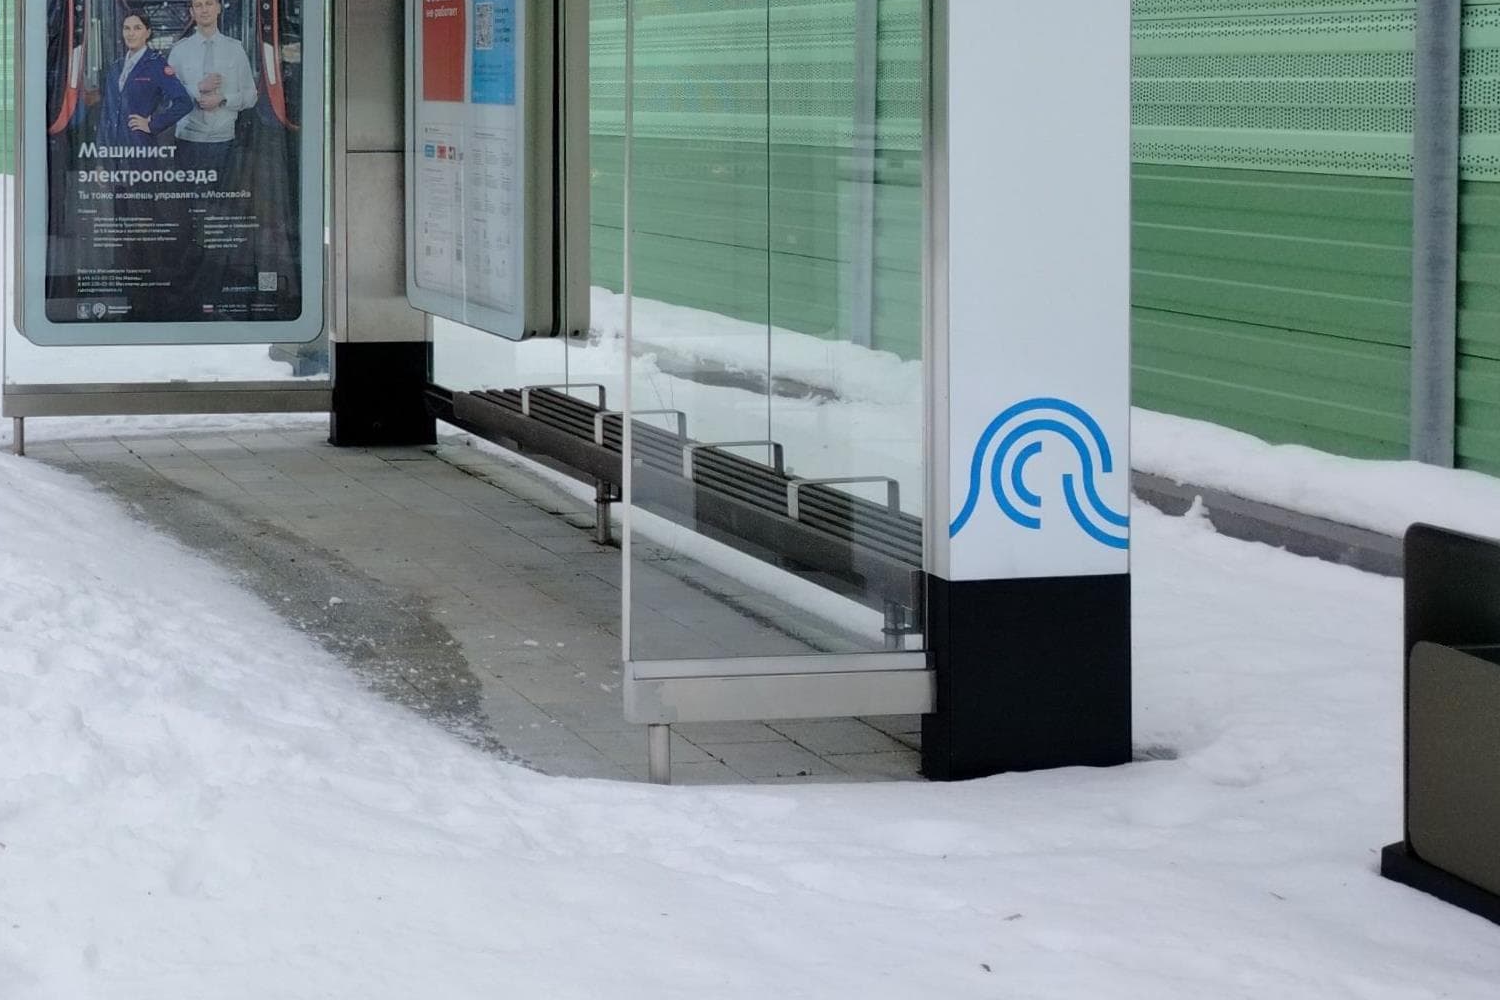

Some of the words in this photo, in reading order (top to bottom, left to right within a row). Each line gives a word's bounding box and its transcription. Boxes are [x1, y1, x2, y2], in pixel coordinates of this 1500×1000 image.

[426, 8, 434, 18] не
[434, 6, 458, 19] работает
[78, 142, 177, 158] Машинист
[78, 169, 218, 187] электропоезда
[78, 190, 90, 200] Ты
[91, 191, 114, 200] тоже
[115, 191, 153, 200] можешь
[154, 191, 200, 201] управлять
[201, 189, 252, 199] «Москвой»
